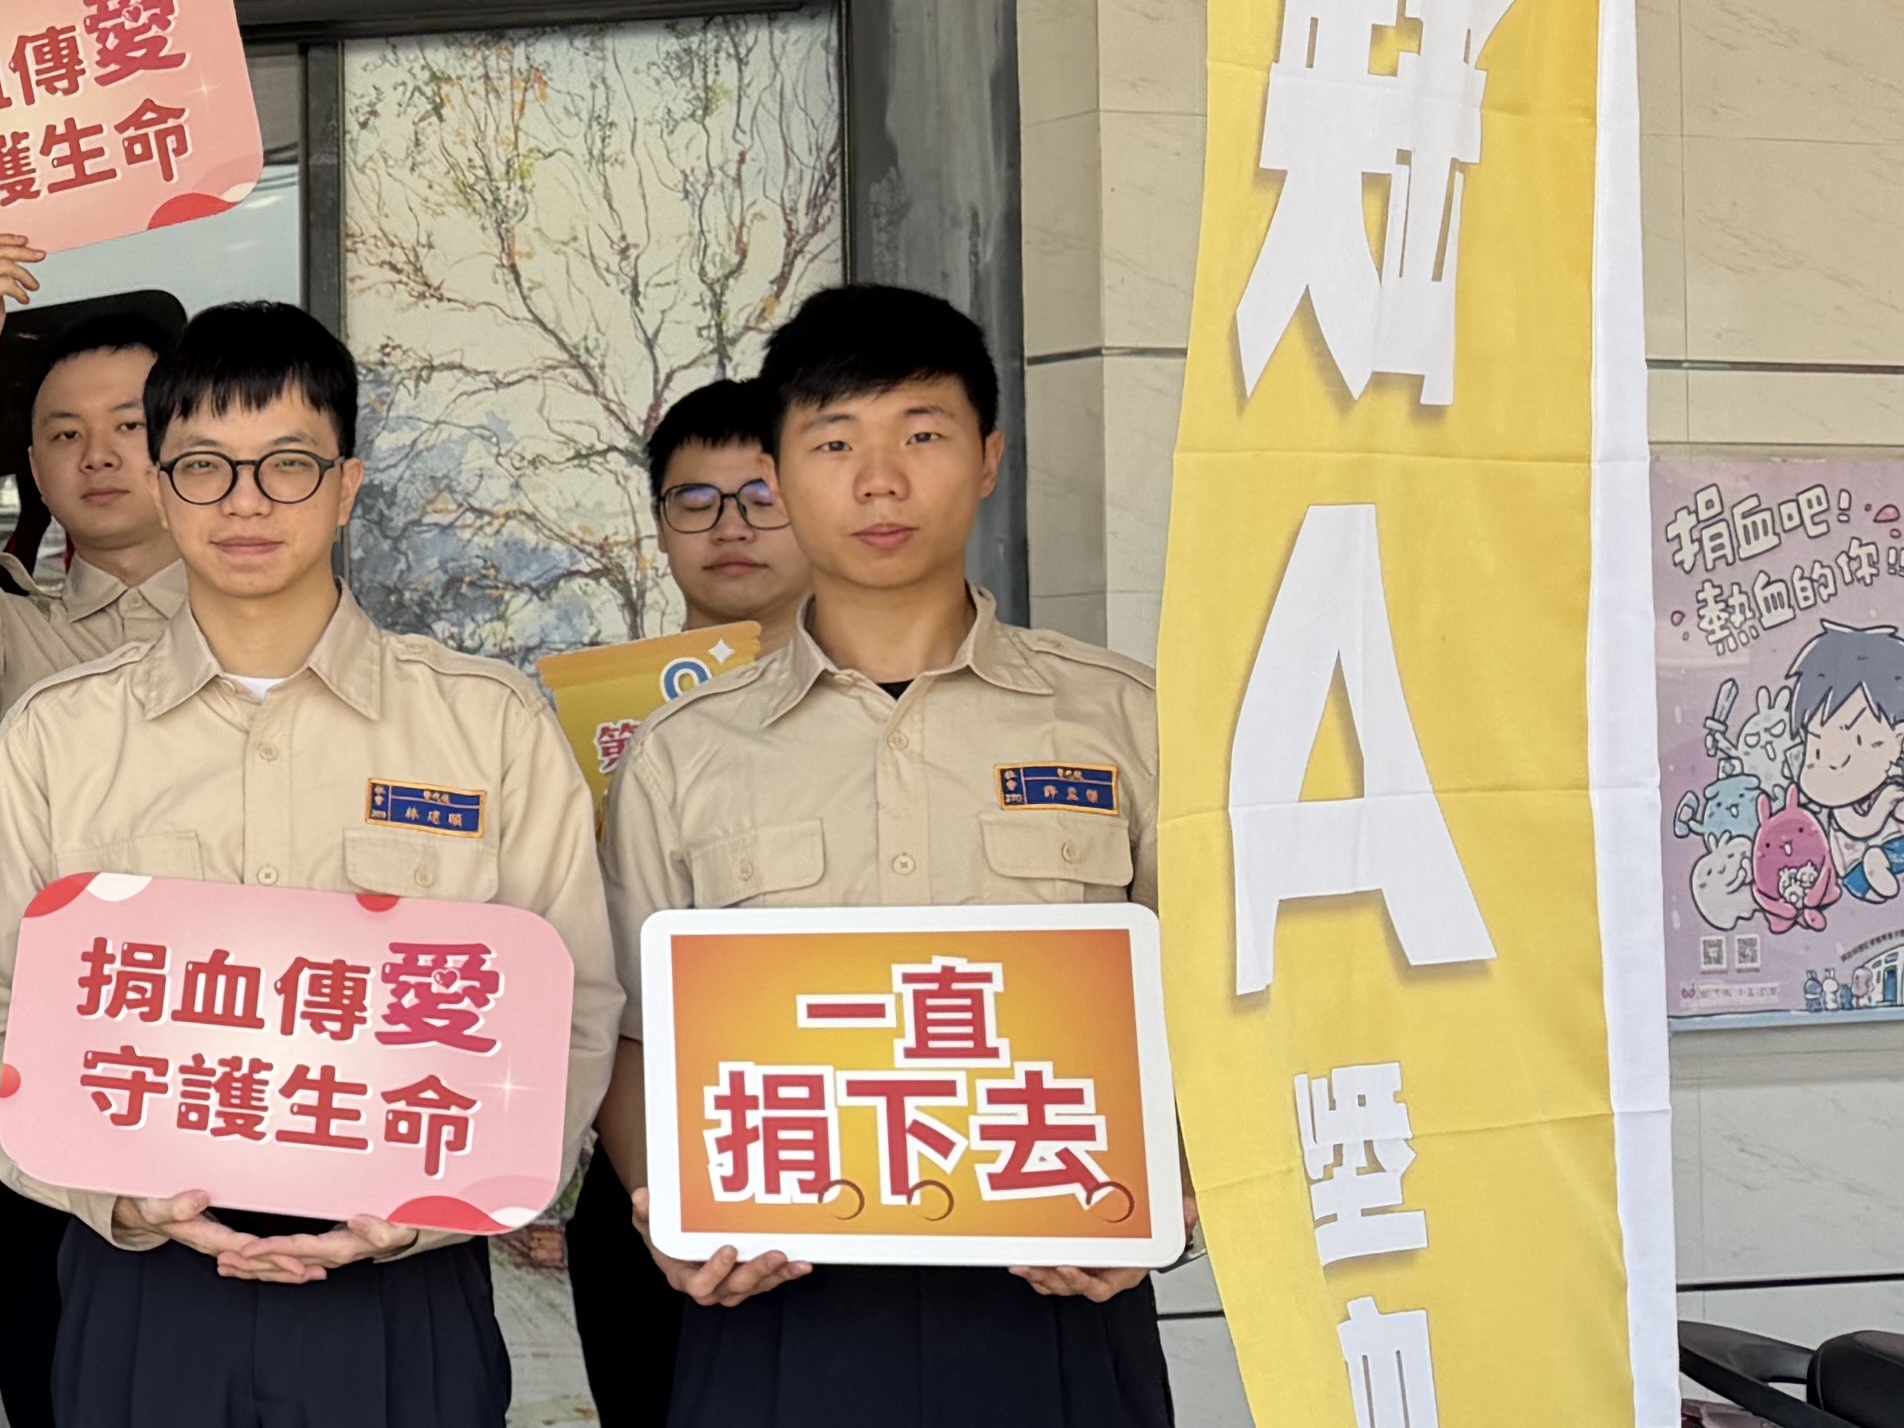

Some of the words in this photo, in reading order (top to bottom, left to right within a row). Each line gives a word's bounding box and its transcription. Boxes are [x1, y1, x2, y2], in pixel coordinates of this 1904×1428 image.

[1666, 483, 1852, 574] 捐血吧!
[76, 936, 503, 1054] 捐血傳愛
[797, 956, 1006, 1068] 一直
[78, 1044, 480, 1177] 守護生命
[706, 1063, 1108, 1207] 捐下去
